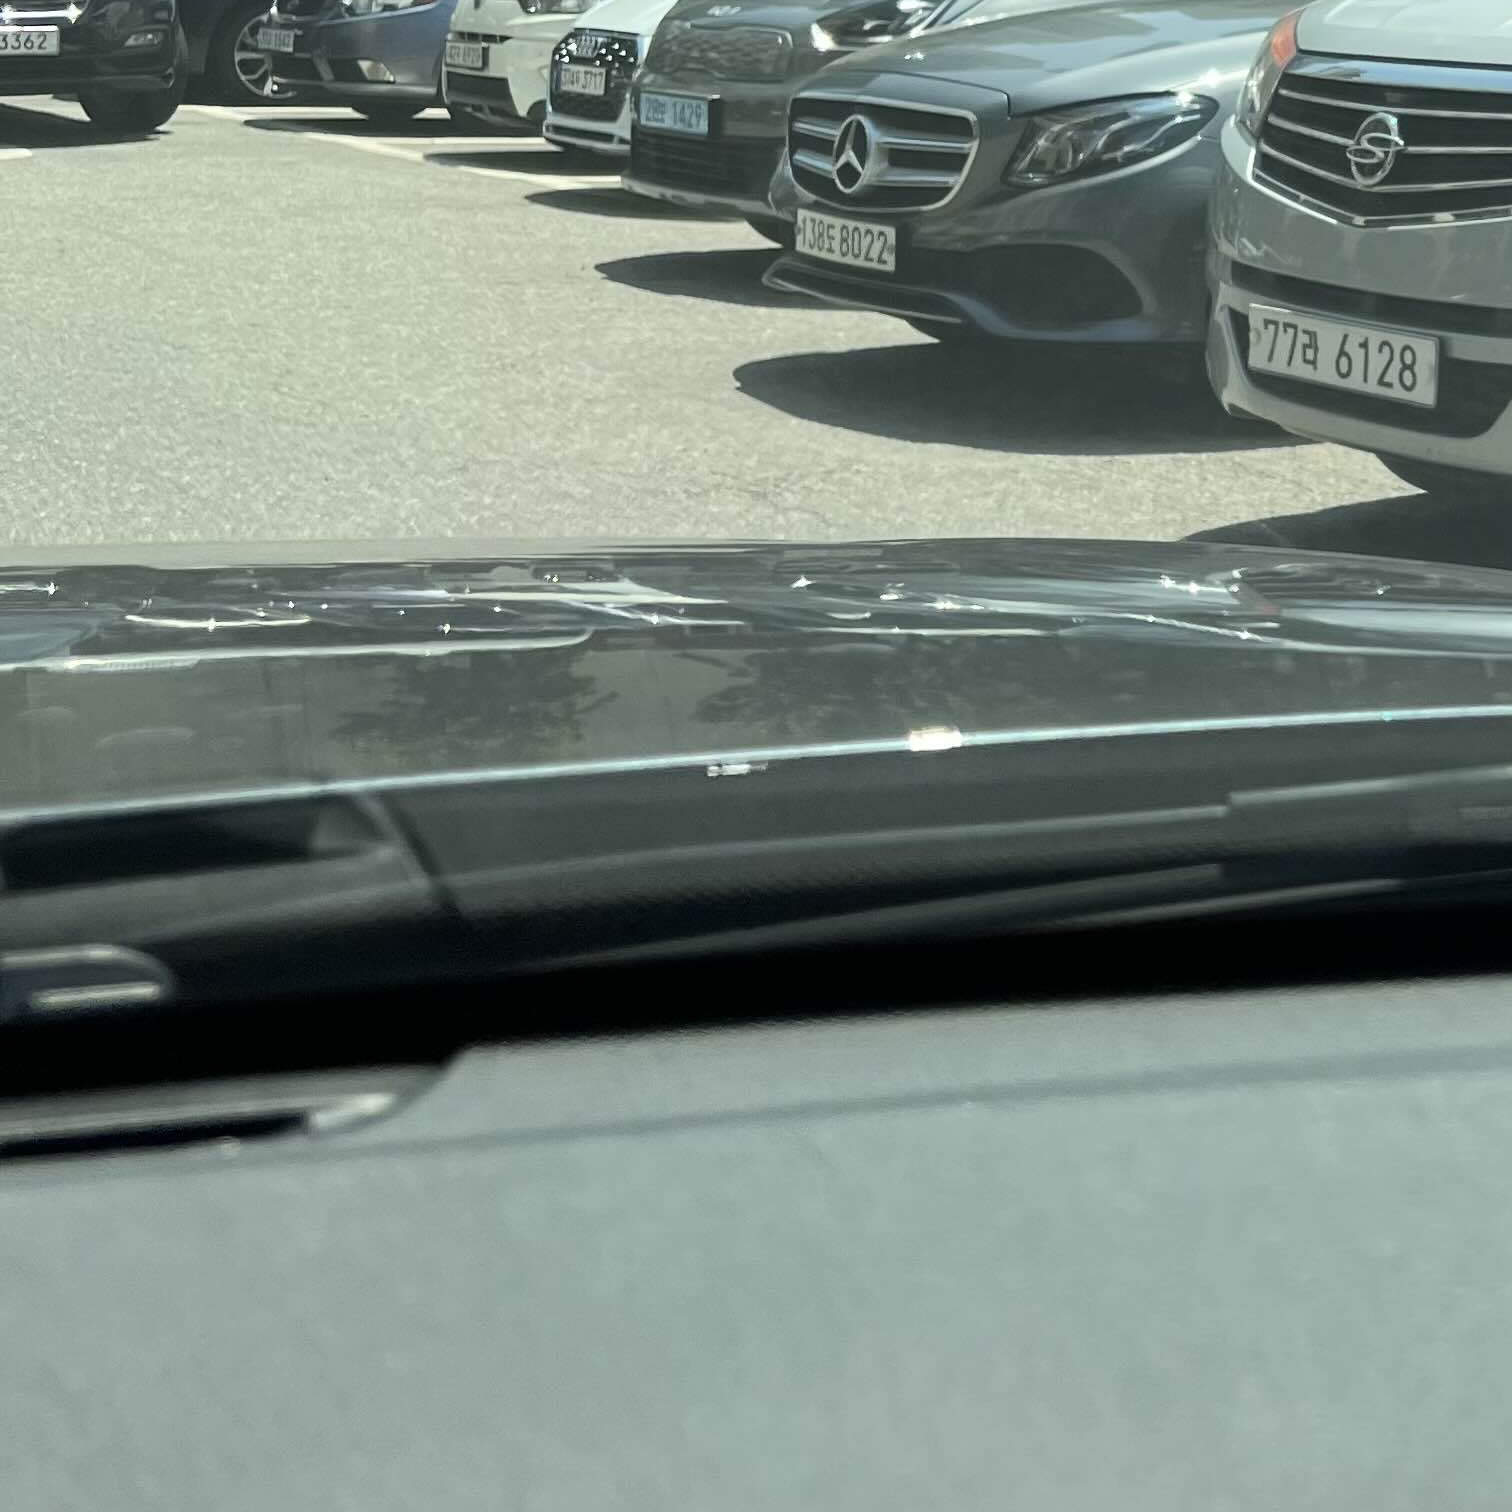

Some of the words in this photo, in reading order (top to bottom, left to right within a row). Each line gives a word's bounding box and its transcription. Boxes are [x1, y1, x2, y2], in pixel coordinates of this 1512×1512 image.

[801, 216, 835, 254] 138도
[840, 224, 888, 264] 8022
[1263, 318, 1319, 371] 77라
[1335, 333, 1417, 393] 6128
